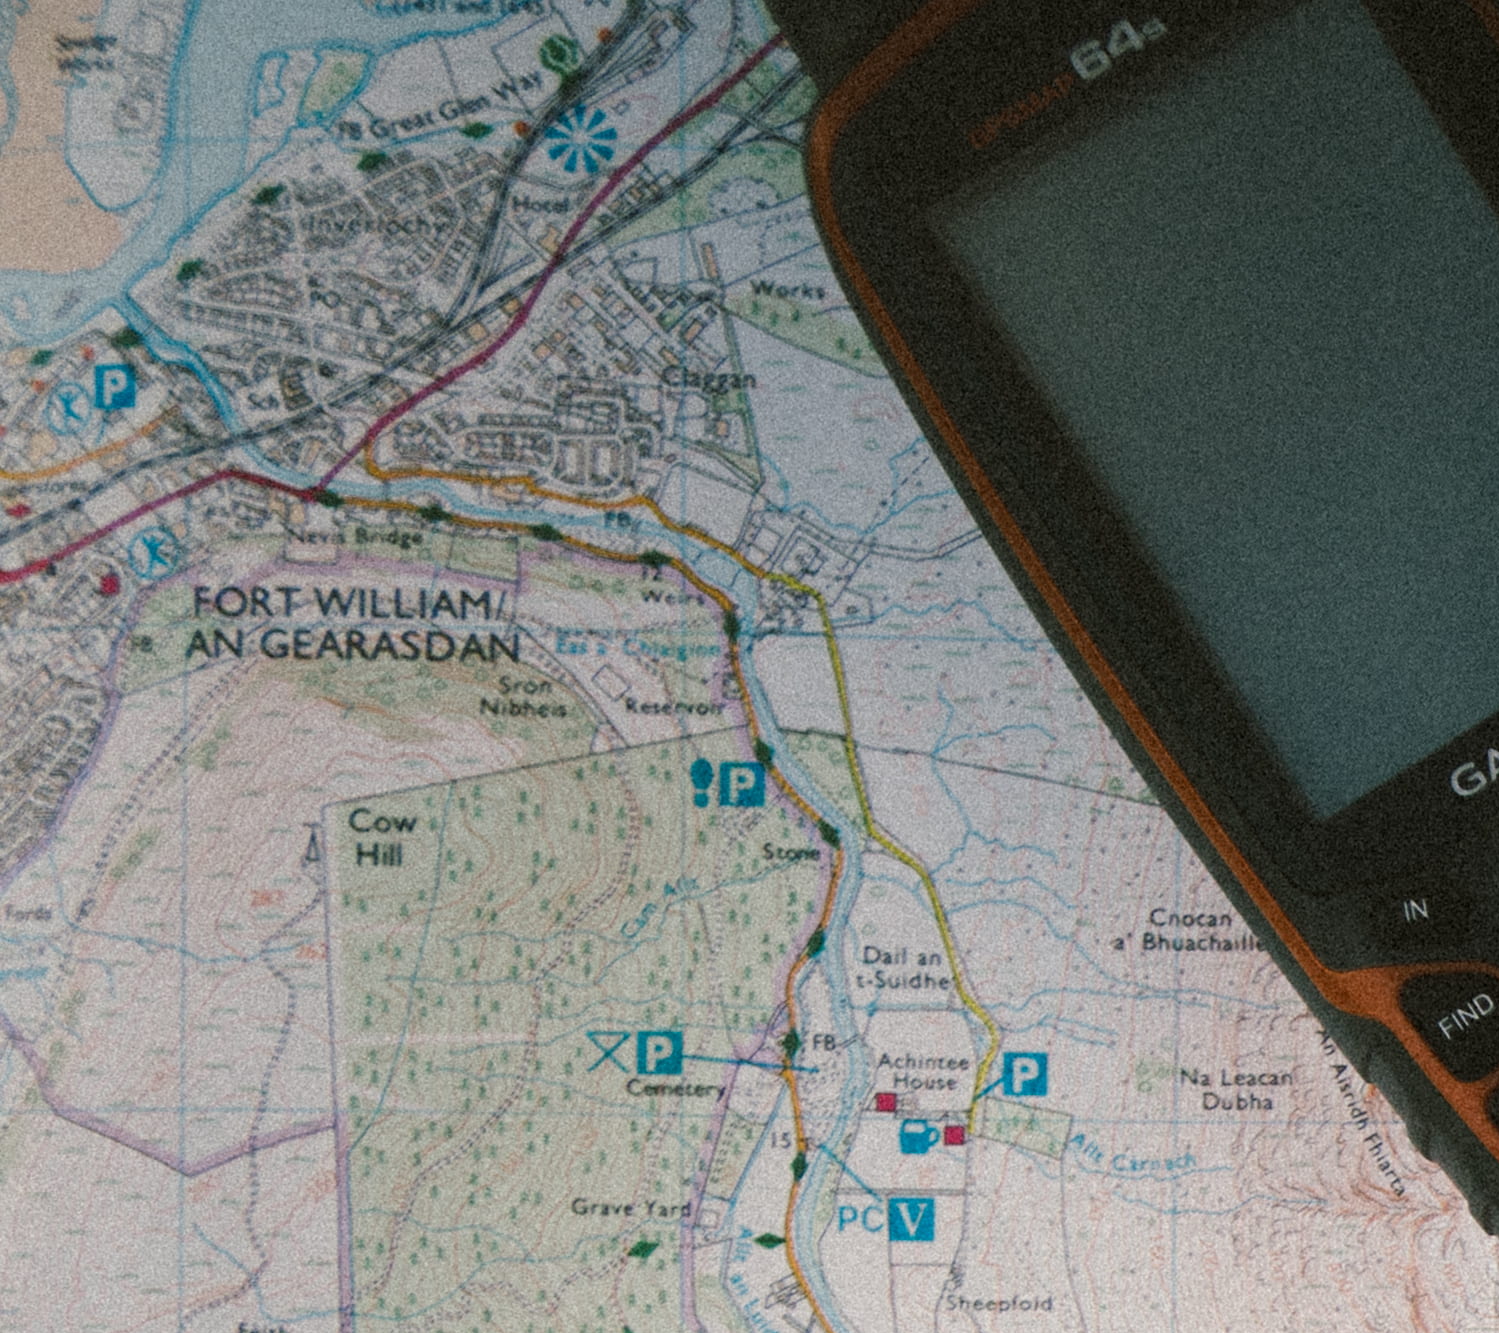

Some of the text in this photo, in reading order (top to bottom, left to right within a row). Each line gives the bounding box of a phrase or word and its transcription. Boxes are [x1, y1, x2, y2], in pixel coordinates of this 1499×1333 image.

[194, 588, 508, 623] FORT WILLIAM/
[186, 630, 520, 664] AN GEARASDAN
[348, 808, 417, 838] Cow
[355, 842, 403, 869] Hill
[1403, 897, 1431, 923] IN
[1436, 991, 1497, 1042] FIND
